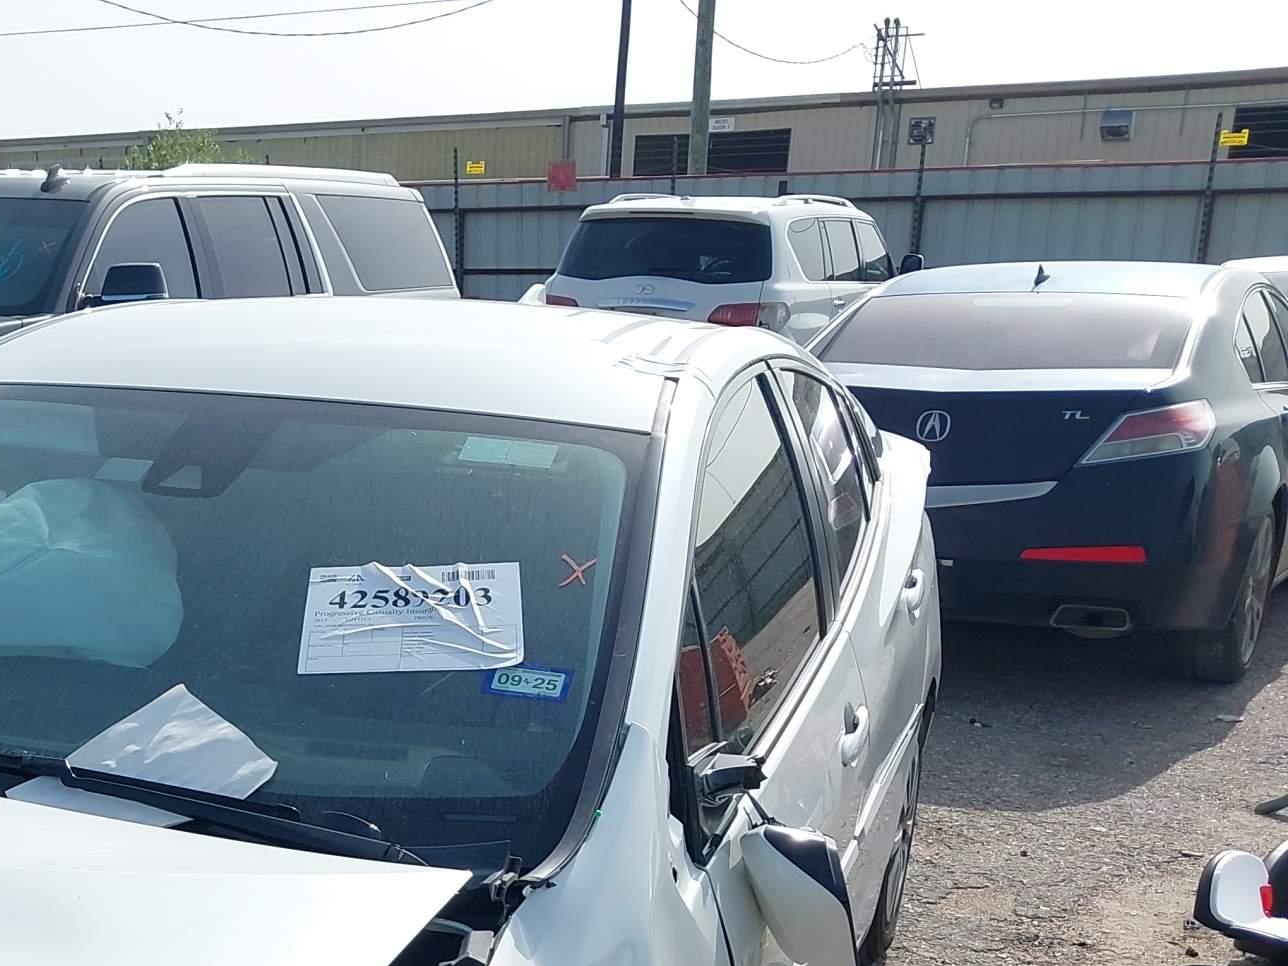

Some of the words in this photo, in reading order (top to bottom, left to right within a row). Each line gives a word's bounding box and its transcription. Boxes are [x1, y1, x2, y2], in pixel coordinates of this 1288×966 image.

[1062, 410, 1090, 420] TL
[314, 610, 364, 618] Progressive
[366, 608, 403, 616] Casualty
